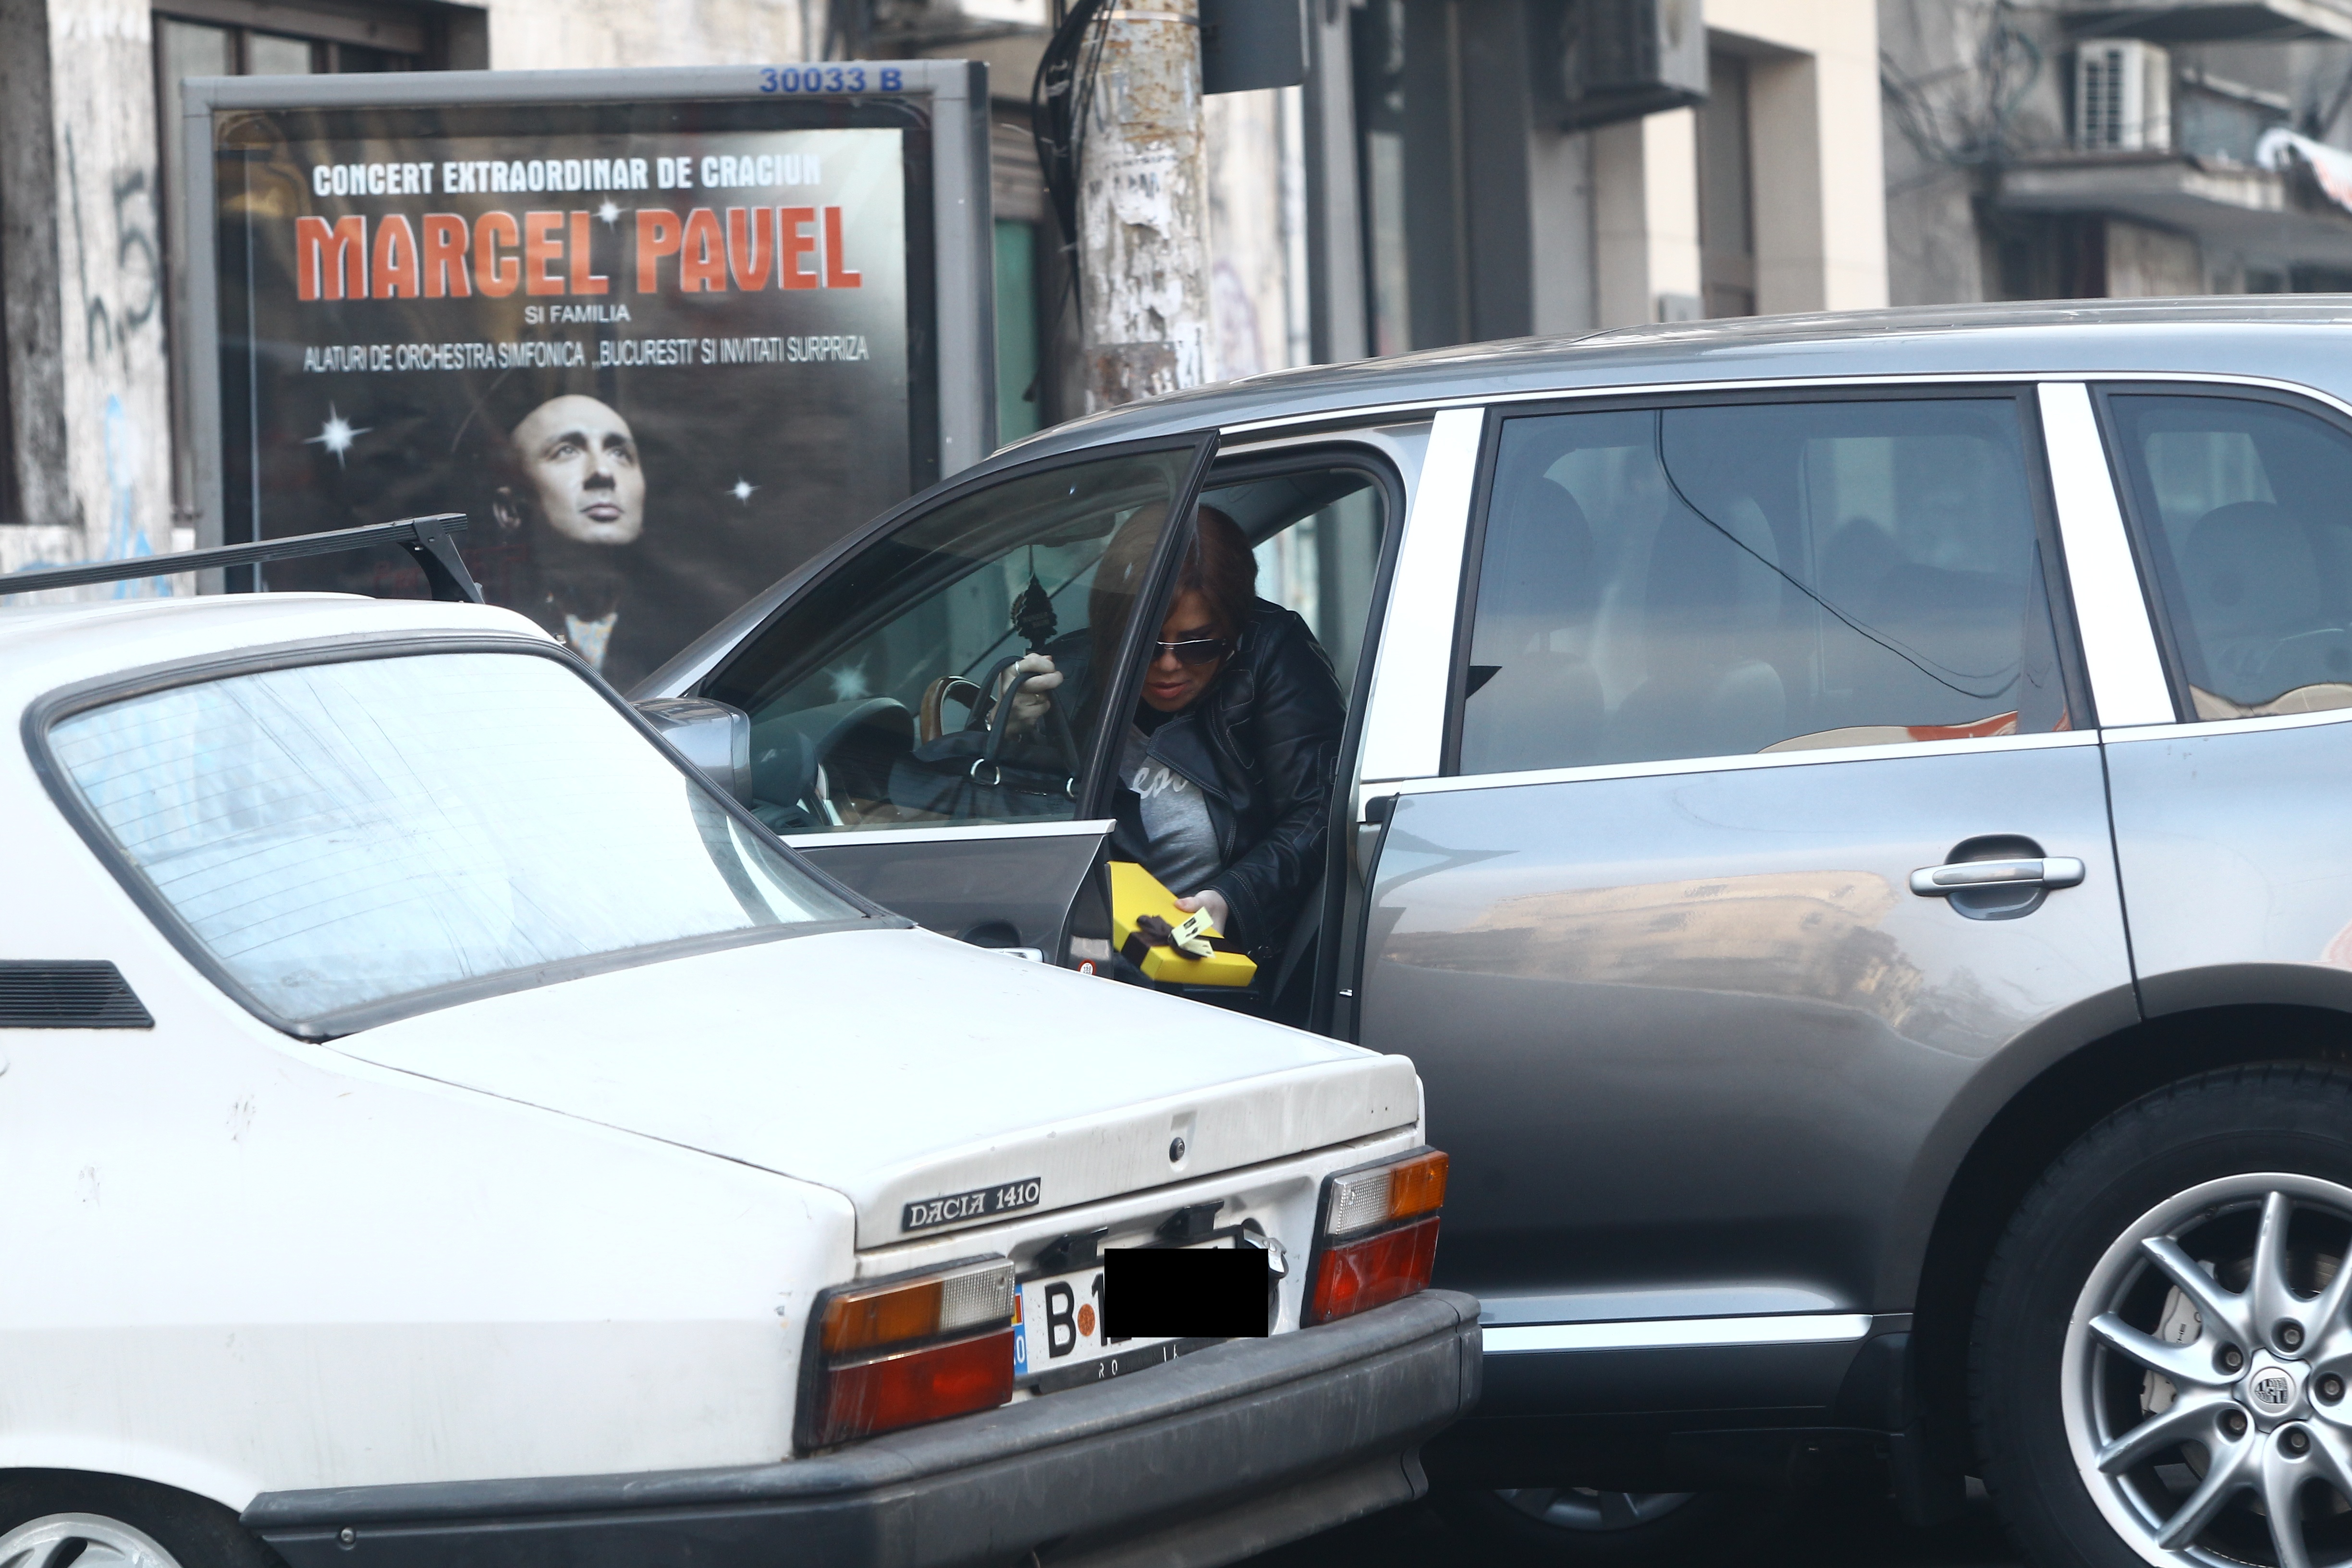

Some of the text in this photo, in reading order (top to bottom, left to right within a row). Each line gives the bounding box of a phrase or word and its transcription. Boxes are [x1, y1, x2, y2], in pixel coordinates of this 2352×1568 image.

[760, 67, 903, 92] 30033 B
[313, 154, 821, 196] CONCERT EXTRAORDINAR DE CRACIUN
[296, 205, 863, 300] MARCEL PAVEL
[525, 304, 631, 324] SI FAMILIA
[303, 345, 367, 372] ALATURI
[370, 345, 392, 371] DE
[395, 343, 496, 371] ORCHESTRA
[498, 341, 586, 369] SIMFONICA
[700, 338, 717, 365] SI
[721, 337, 784, 364] INVITATI
[787, 335, 870, 362] SURPRIZA
[909, 1182, 1039, 1227] DACIA 1410
[1044, 1281, 1077, 1359] B
[1014, 1335, 1025, 1364] O
